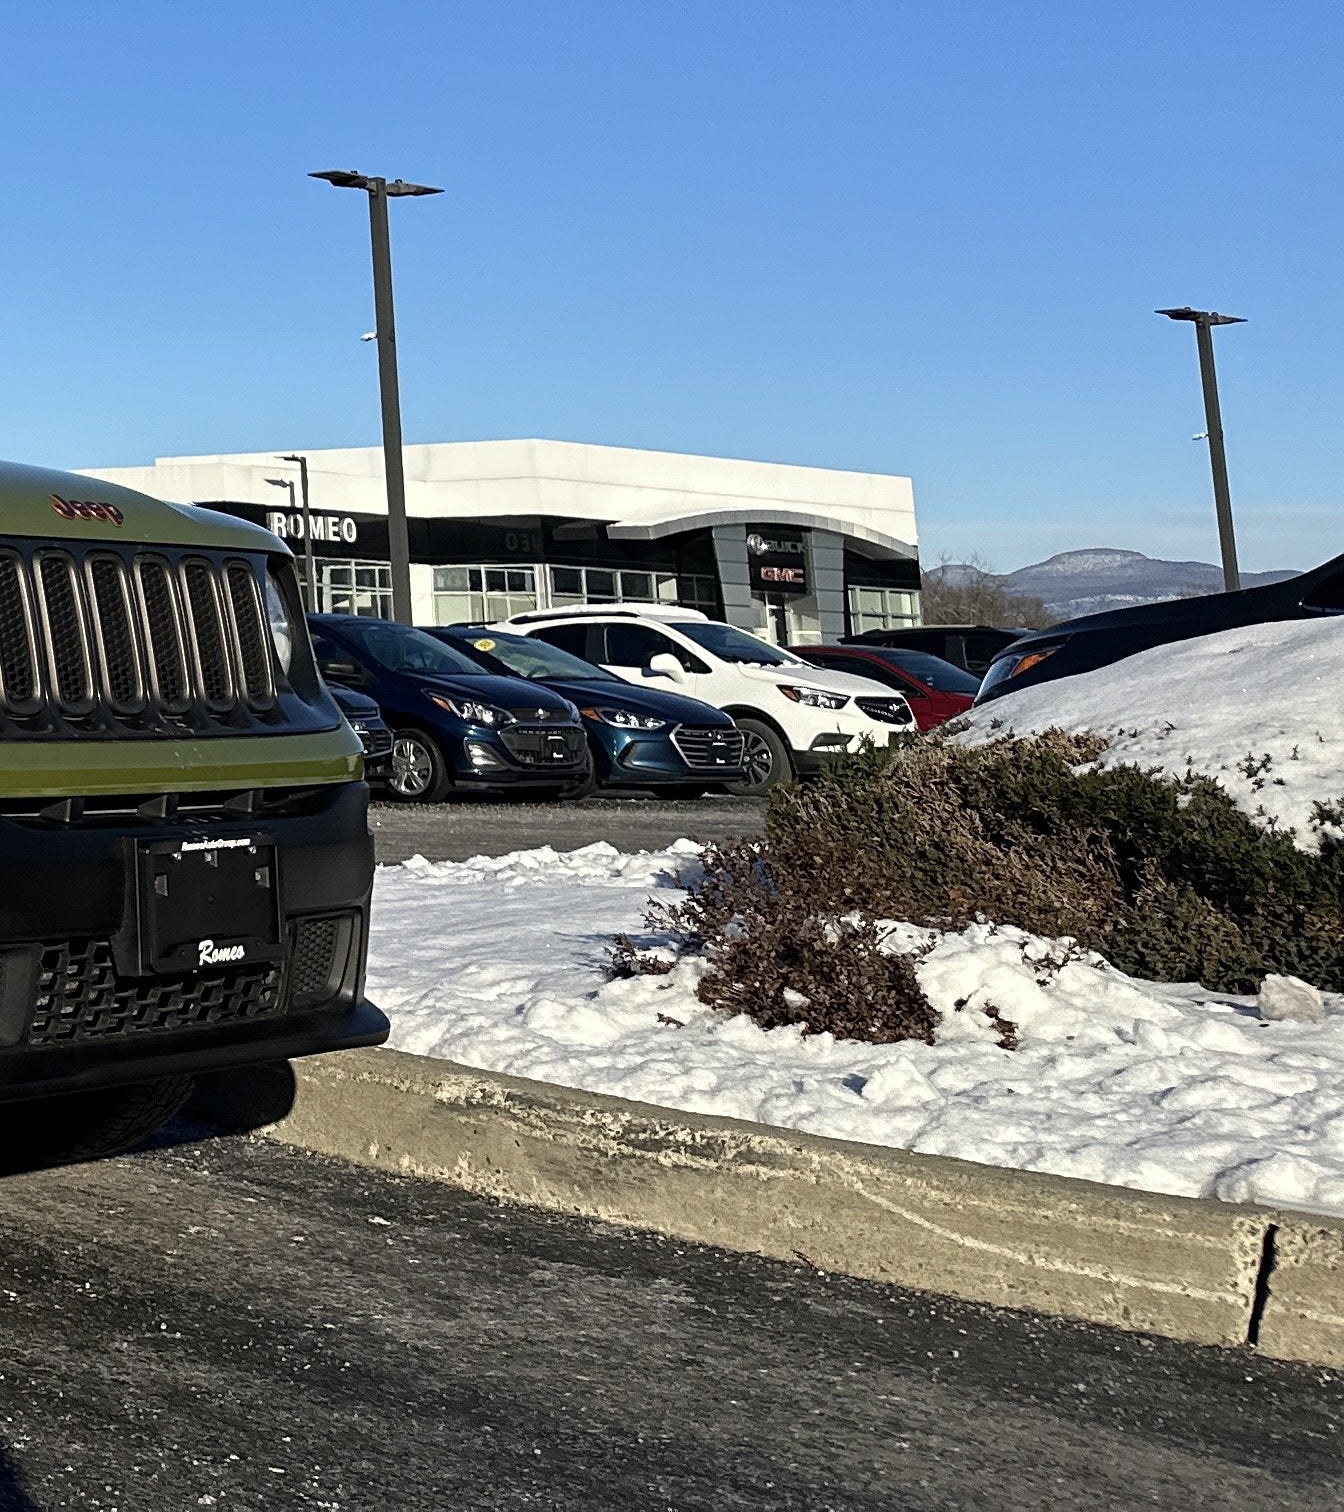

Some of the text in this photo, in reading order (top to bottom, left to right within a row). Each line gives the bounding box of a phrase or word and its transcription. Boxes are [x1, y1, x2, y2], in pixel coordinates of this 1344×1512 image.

[48, 494, 124, 528] Jeep
[266, 511, 357, 543] ROMEO
[760, 566, 805, 584] GMC
[198, 939, 245, 966] Romeo
